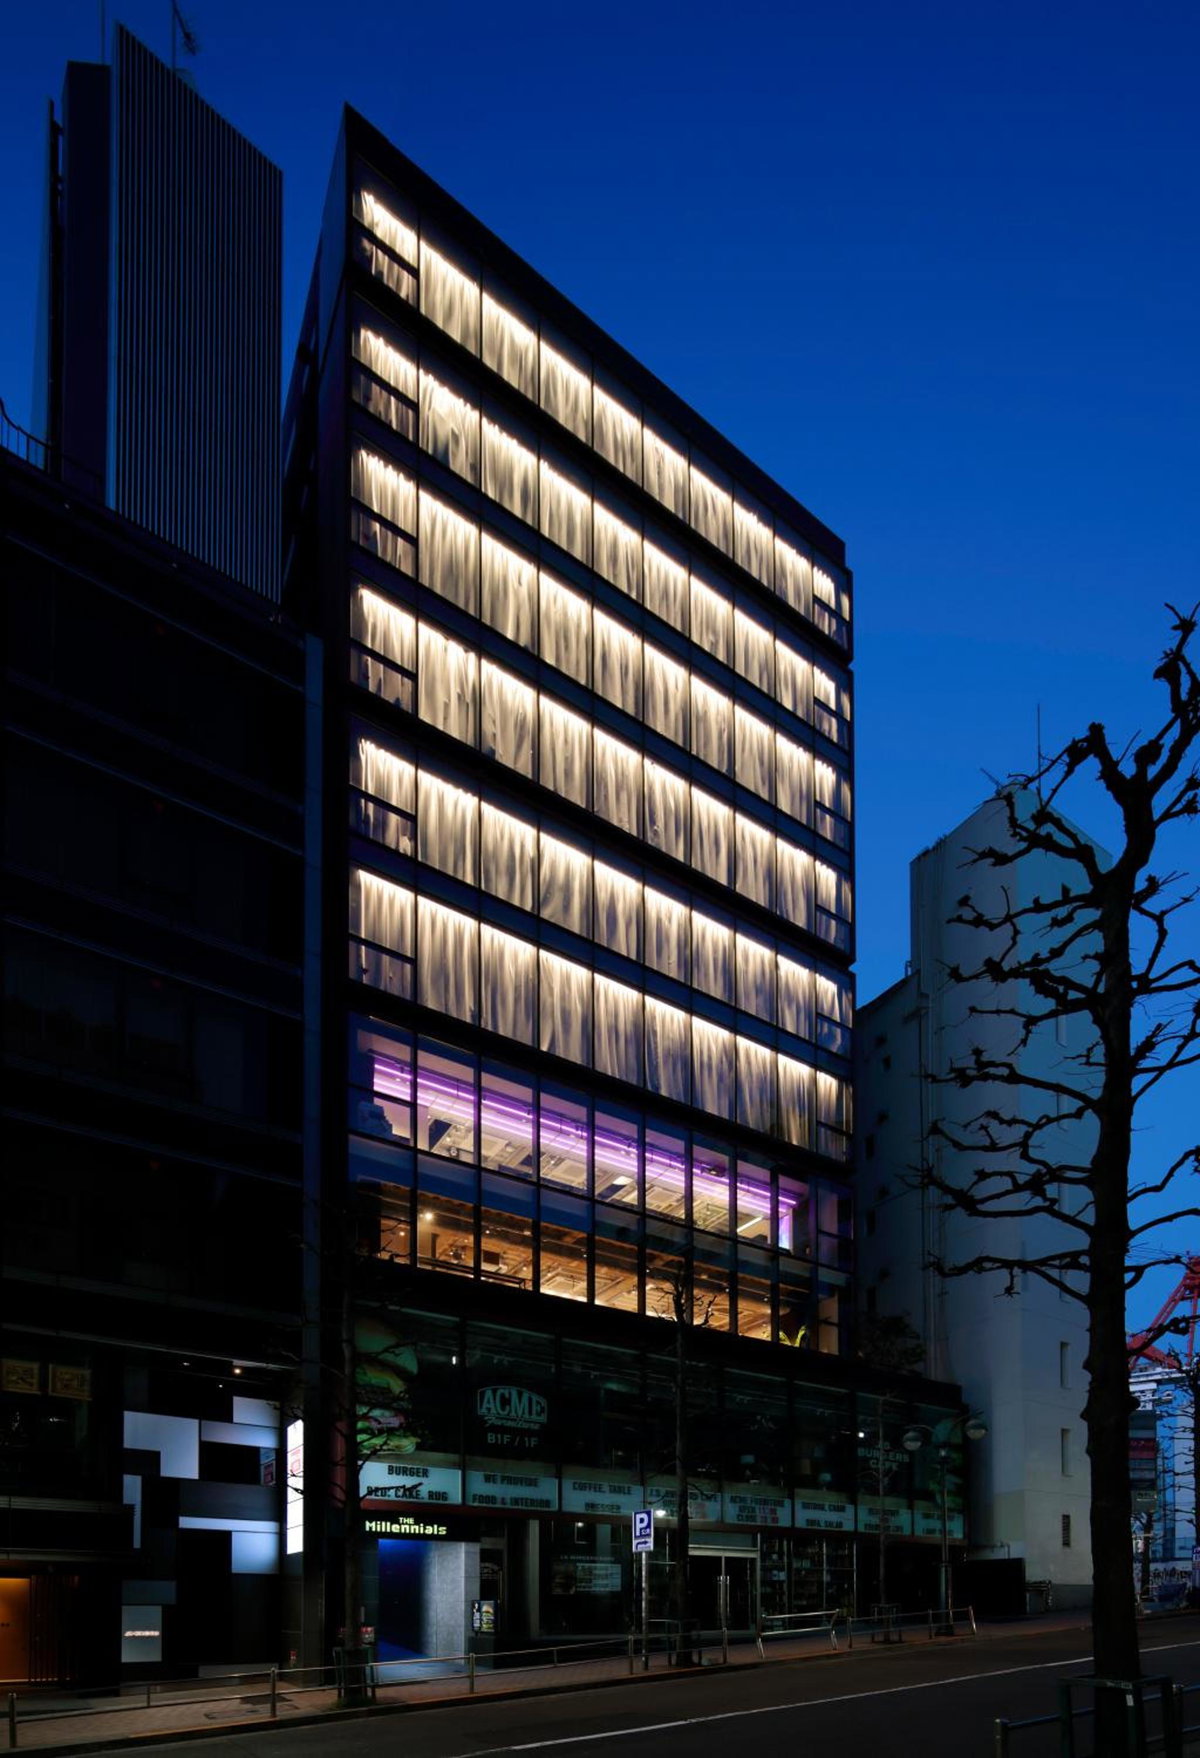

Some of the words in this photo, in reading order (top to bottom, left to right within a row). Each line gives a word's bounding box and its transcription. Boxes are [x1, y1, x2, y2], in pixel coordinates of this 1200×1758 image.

[480, 1388, 545, 1422] ACME
[388, 1465, 429, 1478] BURGER
[483, 1474, 498, 1484] WE
[608, 1484, 632, 1495] TABLE
[428, 1490, 448, 1502] RUG
[472, 1494, 497, 1505] FOOD
[398, 1517, 415, 1525] THE
[635, 1512, 649, 1537] P
[364, 1520, 448, 1535] Millennials
